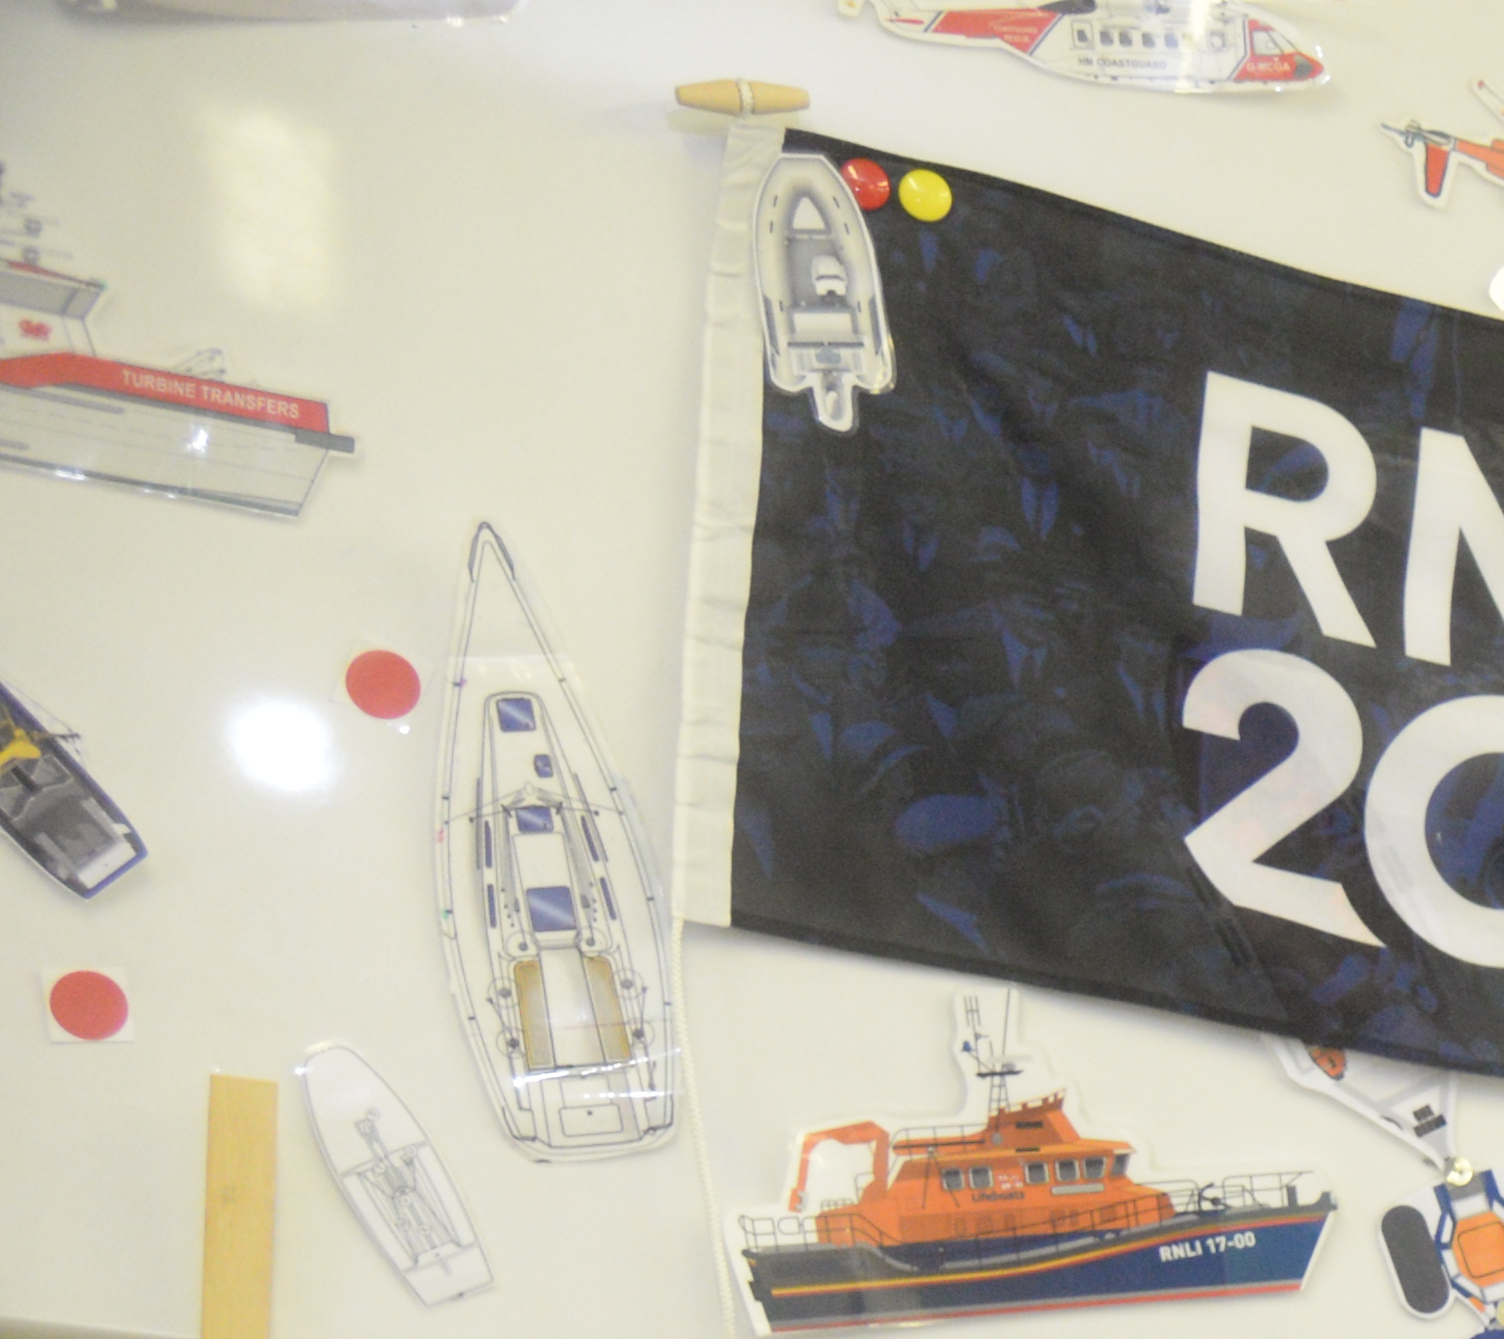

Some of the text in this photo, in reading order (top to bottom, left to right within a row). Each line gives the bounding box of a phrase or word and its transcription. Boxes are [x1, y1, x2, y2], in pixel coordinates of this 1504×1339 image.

[122, 369, 300, 419] TURBINE TRANSFERS
[1158, 1231, 1257, 1263] RNLI 17-00
